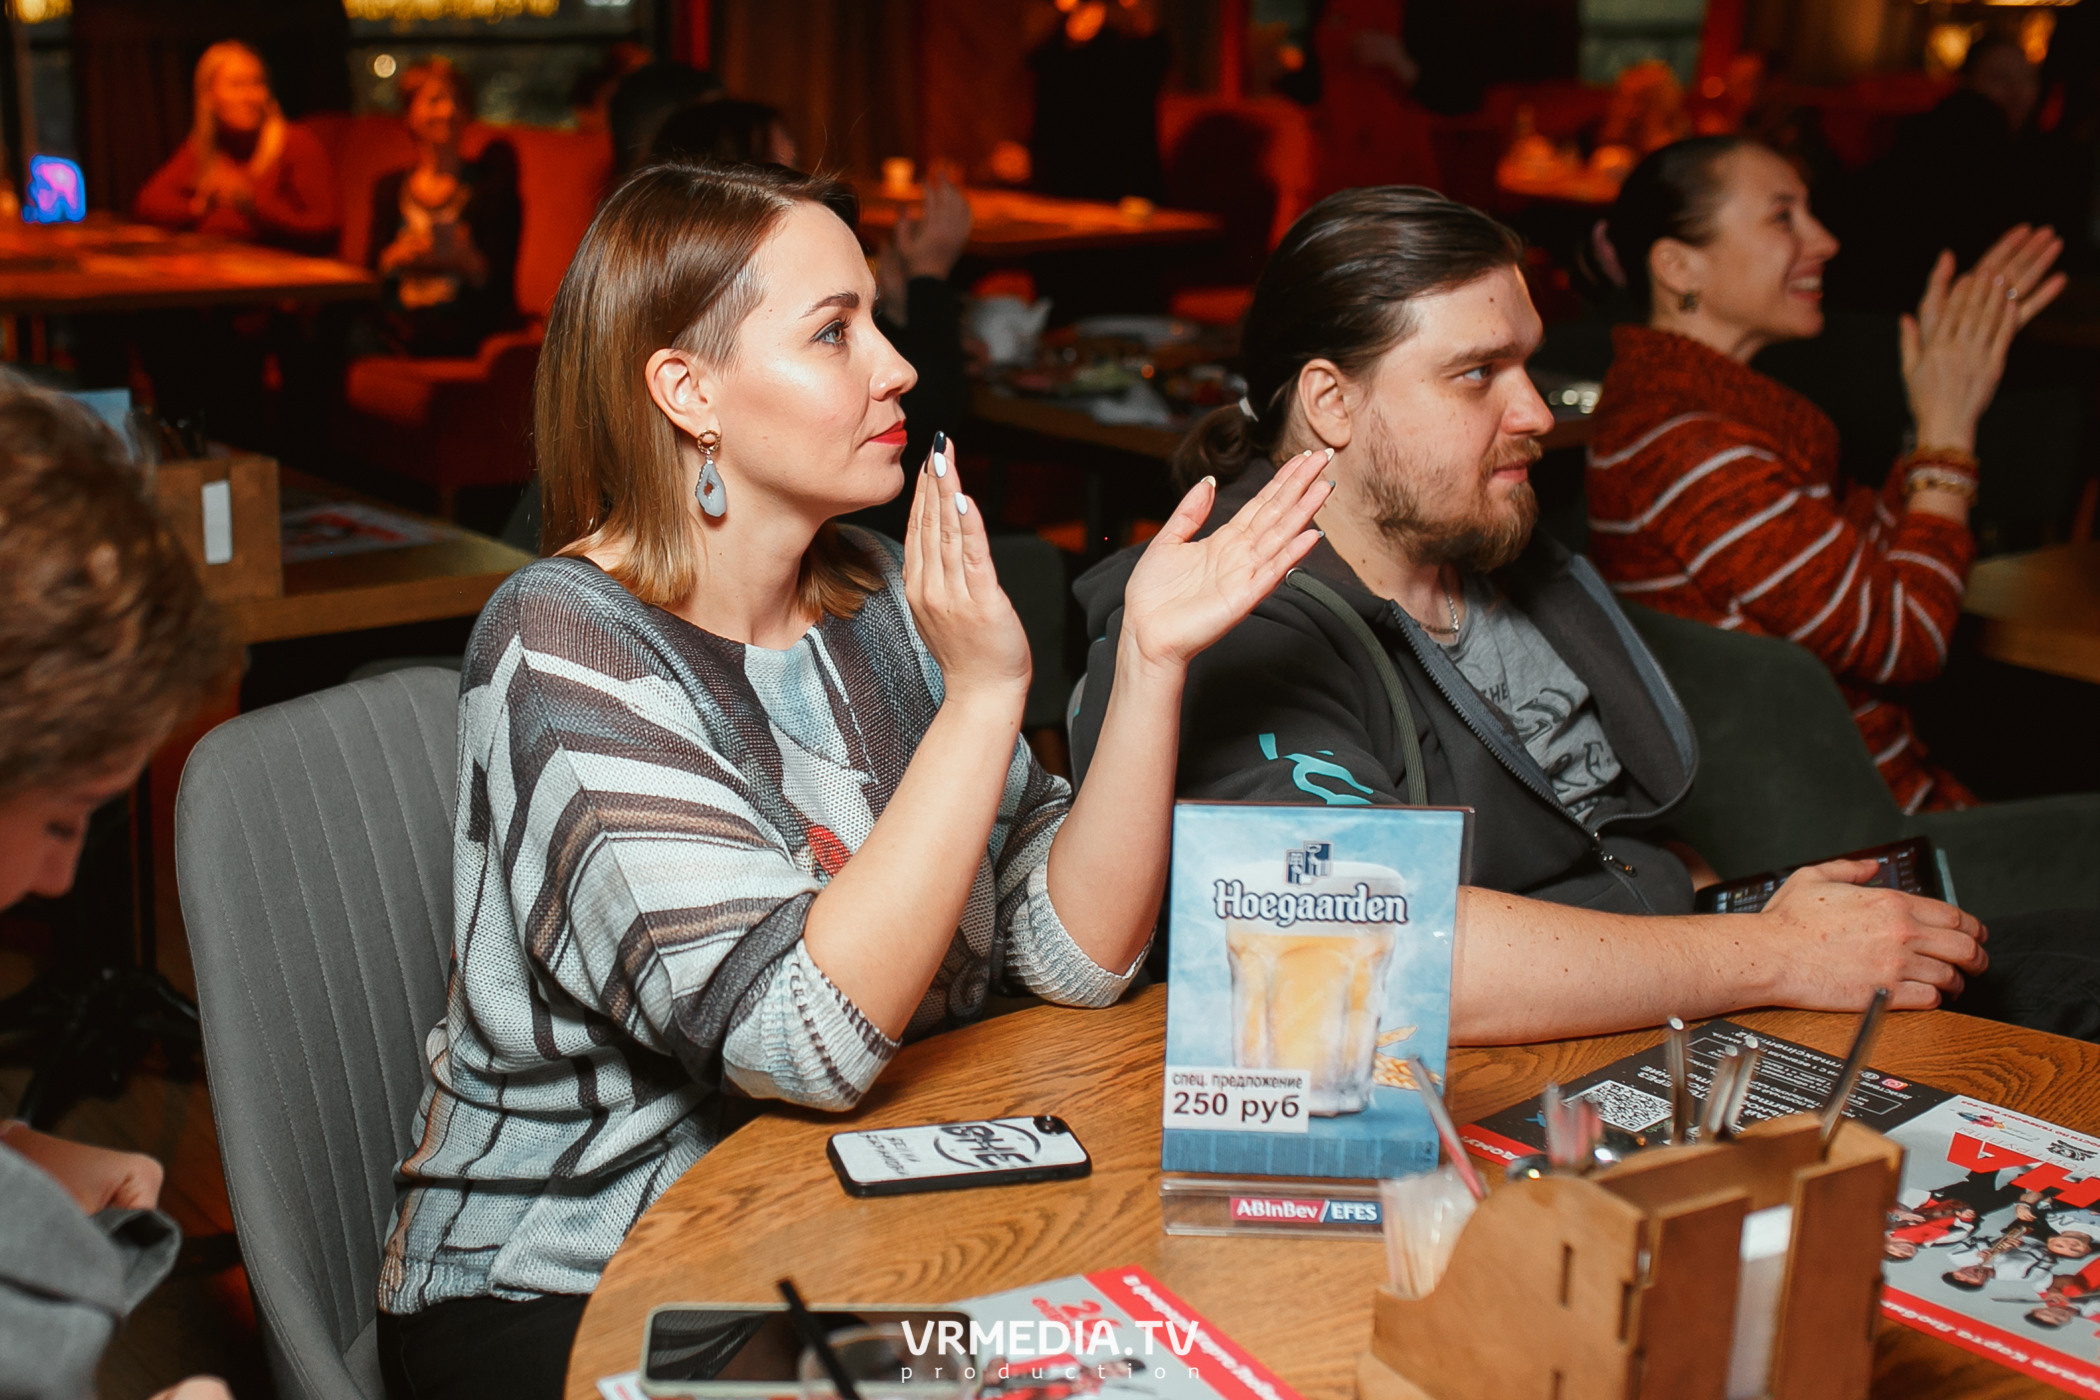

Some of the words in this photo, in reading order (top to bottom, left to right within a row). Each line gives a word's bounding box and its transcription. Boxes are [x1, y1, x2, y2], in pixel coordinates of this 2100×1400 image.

[1213, 878, 1409, 928] Hoegaarden
[1172, 1072, 1207, 1089] спец.
[1212, 1074, 1303, 1091] предложение
[1637, 1071, 1673, 1089] ЕРЕЗ
[1173, 1091, 1228, 1116] 250
[1240, 1094, 1300, 1124] руб
[1330, 1201, 1378, 1221] EFES
[1955, 1329, 2031, 1364] Карта
